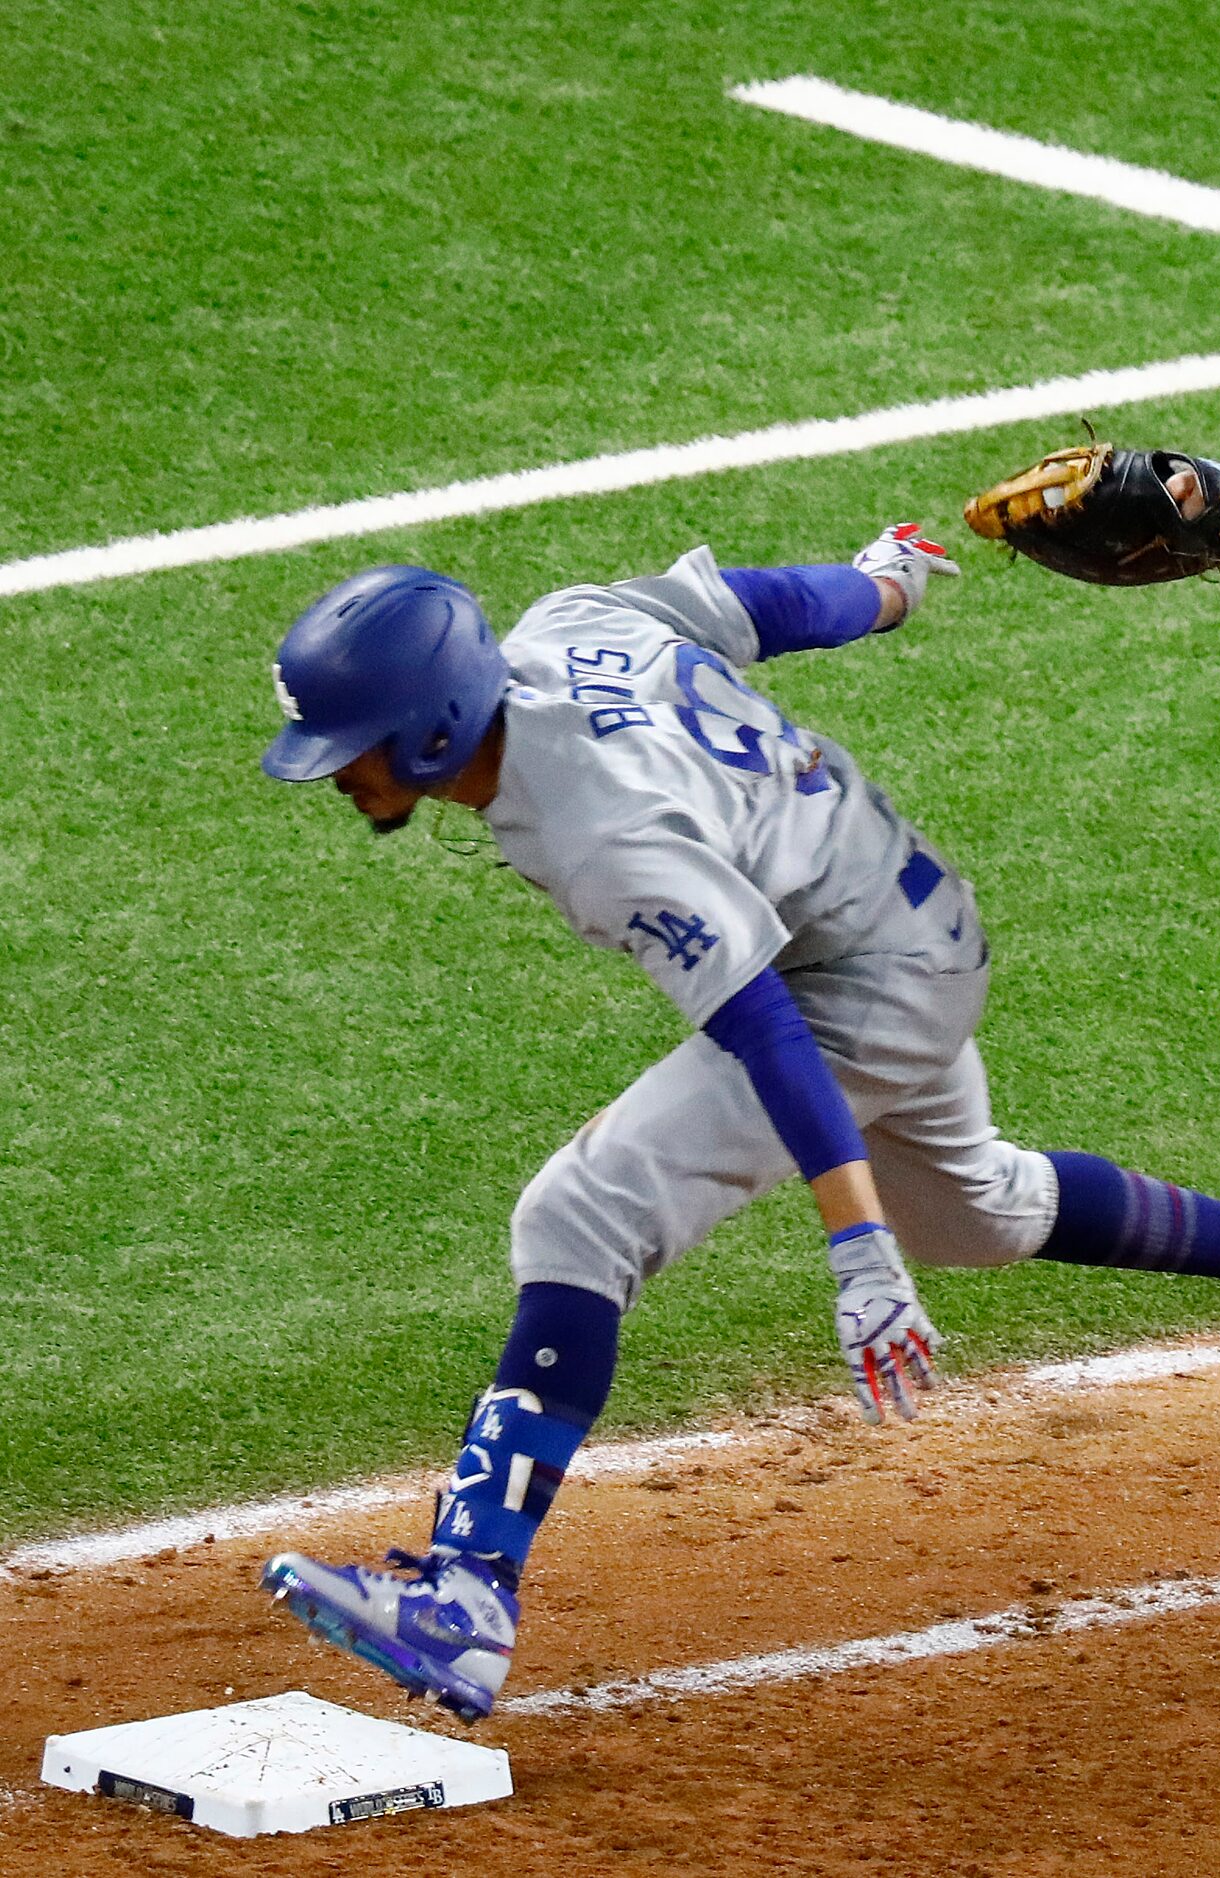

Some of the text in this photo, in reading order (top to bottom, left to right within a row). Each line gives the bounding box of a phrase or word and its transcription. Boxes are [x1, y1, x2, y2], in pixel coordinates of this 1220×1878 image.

[566, 646, 656, 739] BTTS
[627, 910, 720, 972] LA
[480, 1404, 503, 1441] LA
[451, 1500, 474, 1537] LA
